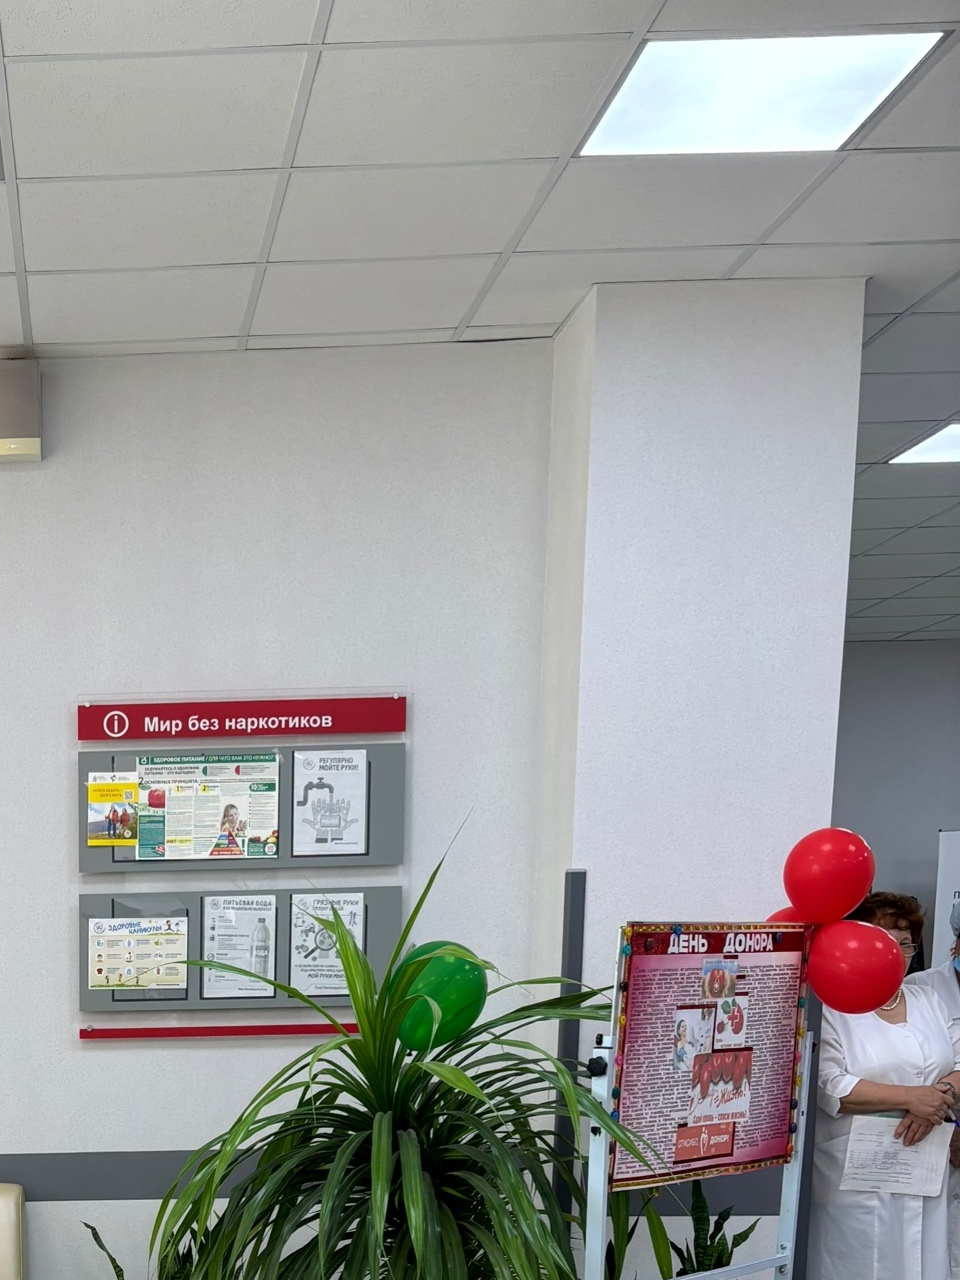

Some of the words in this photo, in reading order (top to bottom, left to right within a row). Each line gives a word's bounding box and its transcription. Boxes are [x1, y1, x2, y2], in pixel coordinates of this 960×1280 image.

[144, 716, 182, 735] Мир
[188, 715, 219, 731] без
[225, 715, 333, 733] наркотиков
[319, 757, 353, 765] РЕГУЛЯРНО
[108, 922, 141, 932] ЗДОРОВЫЕ
[129, 925, 162, 934] КАНИКУЛЫ
[668, 933, 708, 954] ДЕНЬ
[723, 932, 773, 953] ДОНОРА
[710, 1134, 730, 1145] ДОНОР!
